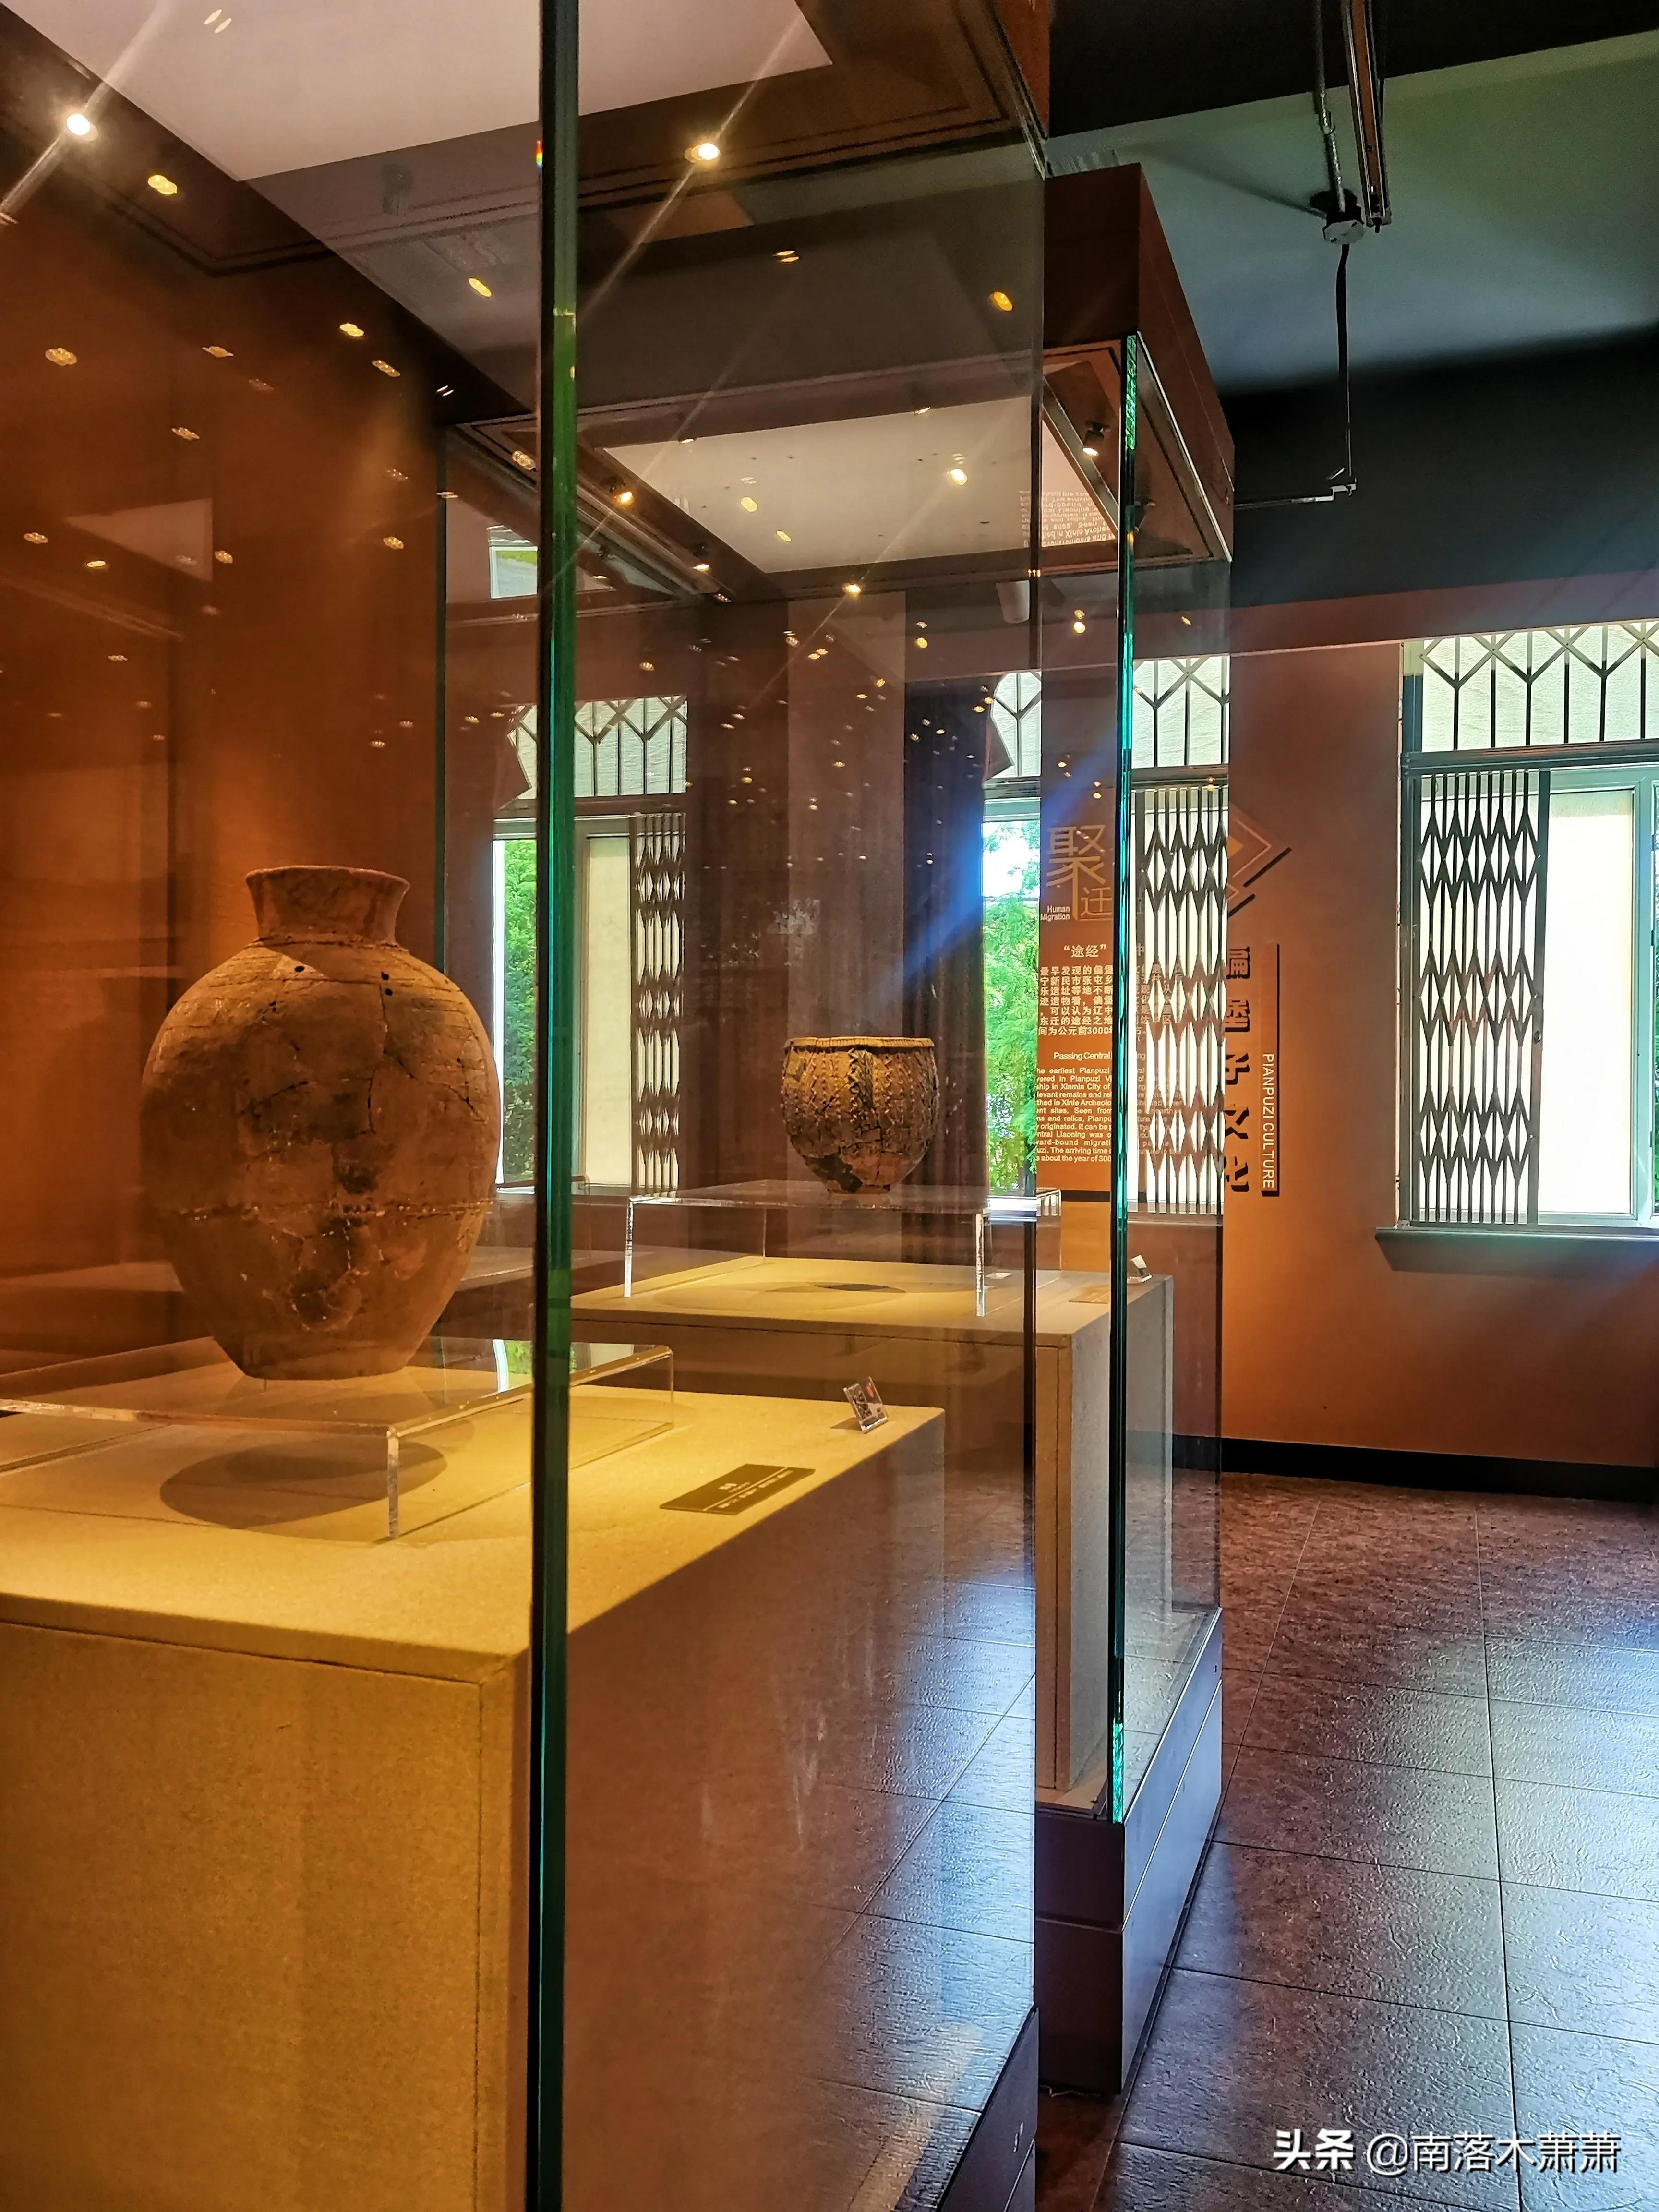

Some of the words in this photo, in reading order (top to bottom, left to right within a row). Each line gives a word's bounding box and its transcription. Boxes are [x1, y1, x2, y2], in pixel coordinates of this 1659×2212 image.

[1046, 824, 1106, 920] 聚
[1041, 913, 1070, 922] Migration
[1053, 1052, 1083, 1061] Passing
[1262, 1053, 1274, 1118] PIANPUZI
[1056, 1130, 1086, 1139] Liaoning
[1065, 1147, 1091, 1155] arriving
[1262, 1122, 1274, 1189] CULTURE
